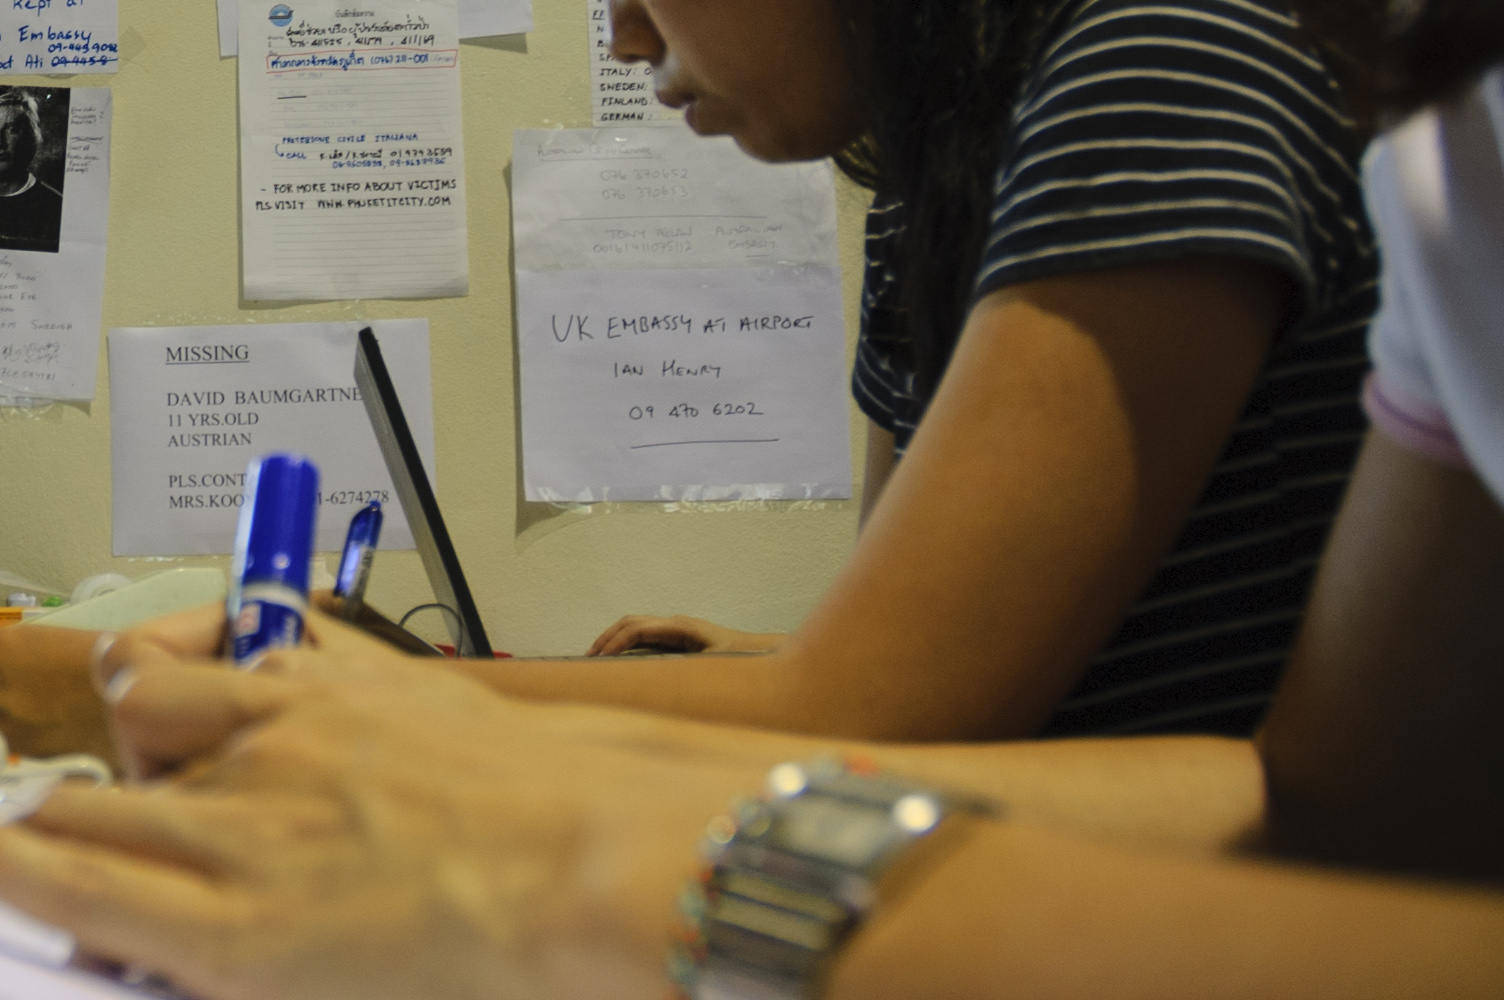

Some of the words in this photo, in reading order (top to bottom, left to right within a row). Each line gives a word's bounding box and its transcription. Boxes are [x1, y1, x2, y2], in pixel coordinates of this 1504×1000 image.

[18, 25, 92, 45] Embassy
[274, 184, 294, 195] FOR
[296, 183, 327, 194] MORE
[330, 182, 361, 193] INFO
[364, 181, 402, 192] ABOUT
[407, 179, 457, 191] VICTIMS
[256, 201, 273, 211] PLS
[275, 200, 305, 211] VISIT
[551, 314, 594, 343] UK
[607, 314, 692, 338] EMBASSY
[703, 318, 728, 333] AT
[739, 315, 815, 331] AIRPORT
[165, 344, 250, 362] MISSING
[613, 362, 644, 377] IAN
[167, 390, 225, 406] DAVID
[235, 386, 364, 404] BAUMGARTNE
[168, 414, 182, 427] 11
[188, 412, 260, 426] YRS.OLD
[629, 404, 654, 421] 09
[669, 403, 699, 418] 470
[712, 401, 764, 417] 6202
[167, 432, 252, 448] AUSTRIAN
[169, 473, 248, 489] PLS.CONT
[169, 493, 247, 510] MRS.KOO
[316, 489, 390, 507] 1-6274278
